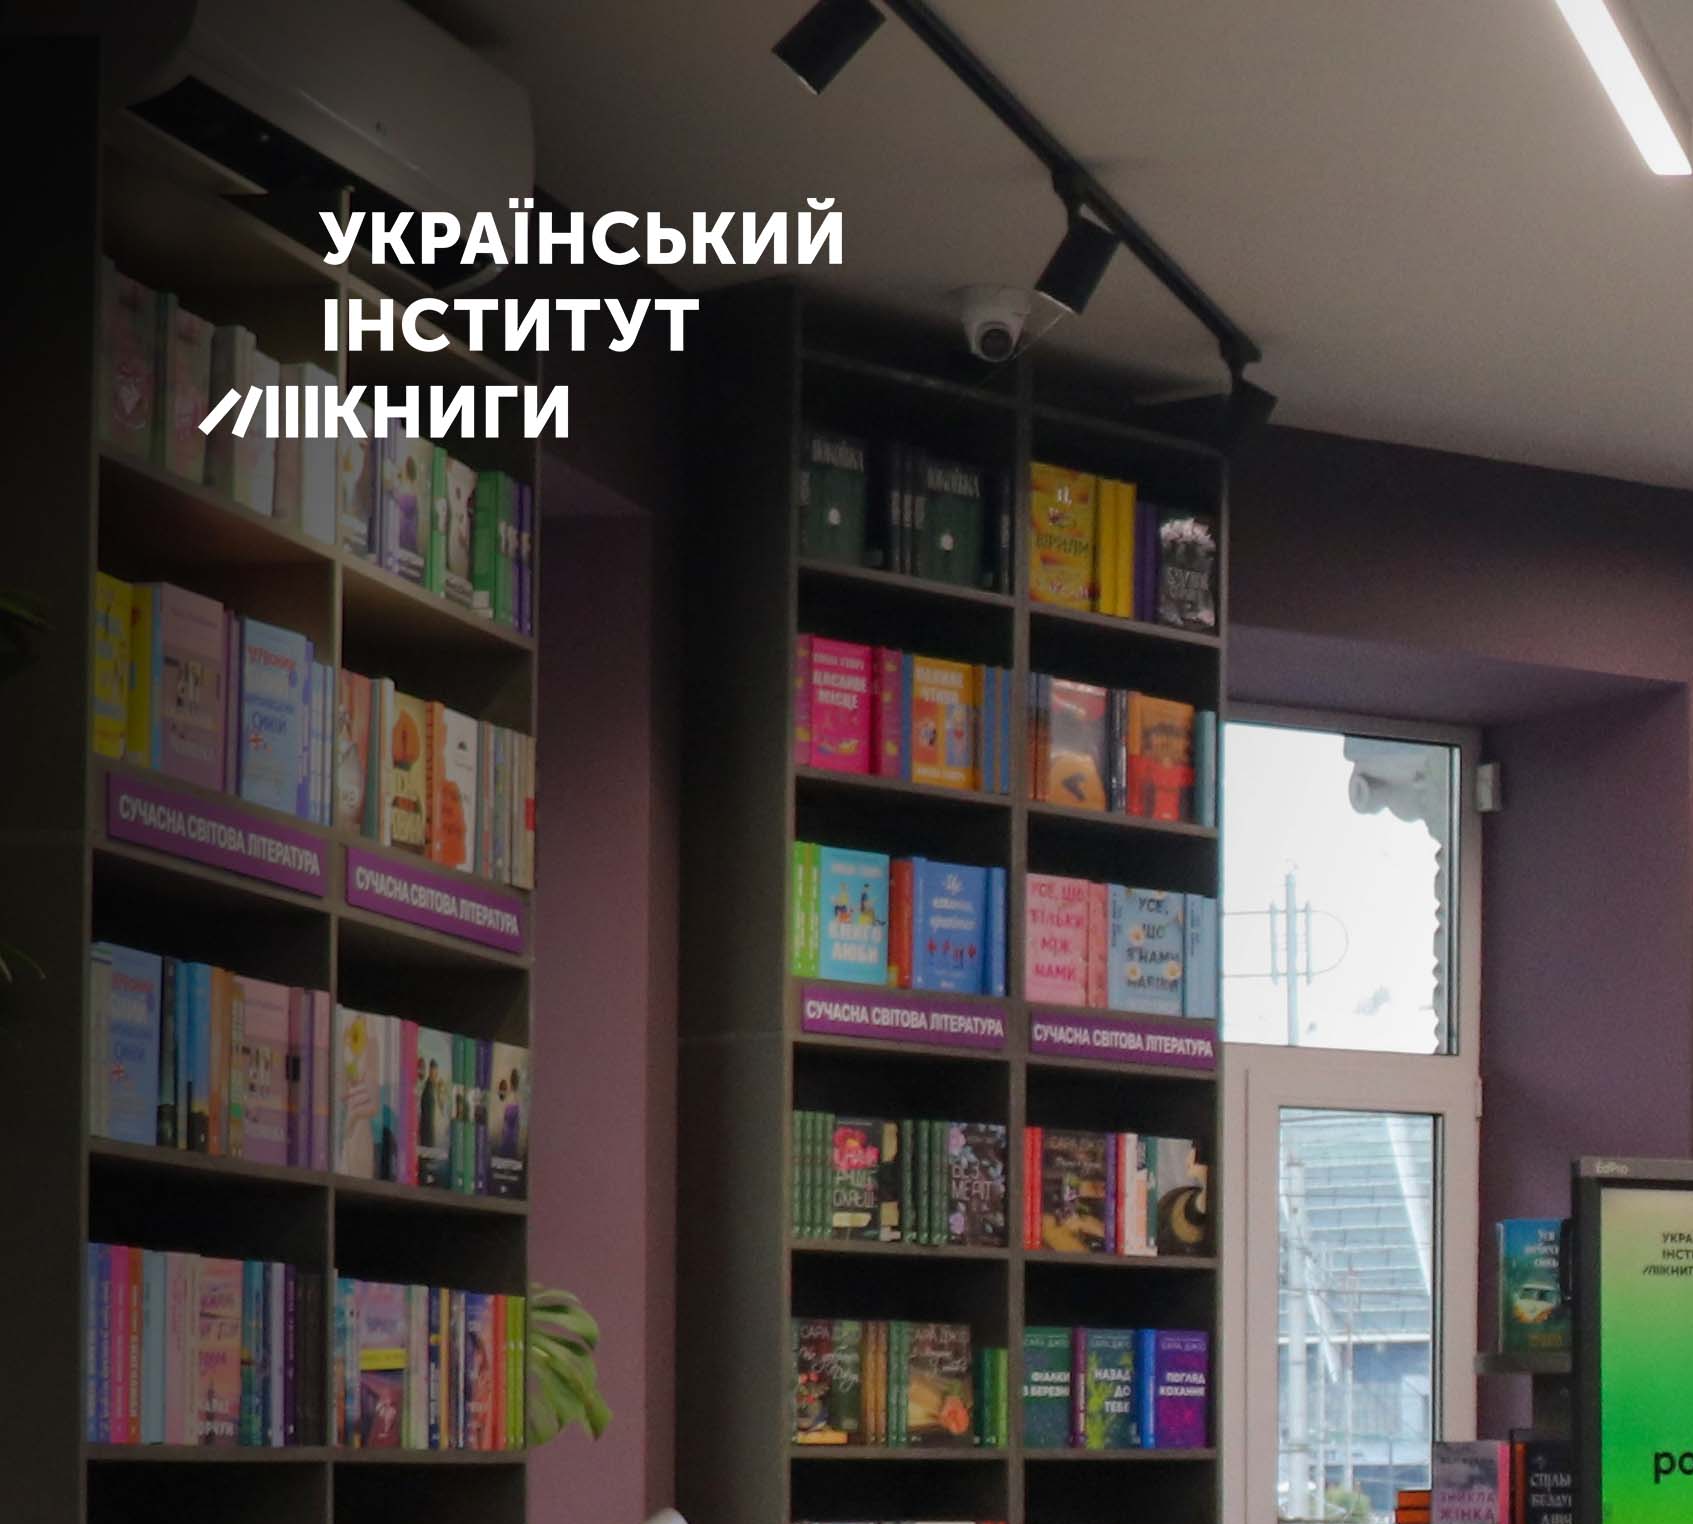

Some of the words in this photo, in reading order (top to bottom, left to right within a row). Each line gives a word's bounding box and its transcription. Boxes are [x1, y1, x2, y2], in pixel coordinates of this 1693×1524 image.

[119, 794, 186, 837] СУЧАСНА
[187, 815, 246, 855] СВІТОВА
[247, 833, 320, 877] ЛІТЕРАТУРА
[356, 865, 410, 905] СУЧАСНА
[410, 883, 458, 919] СВІТОВА
[460, 898, 519, 937] ЛІТЕРАТУРА
[806, 1000, 869, 1024] СУЧАСНА
[872, 1006, 928, 1030] СВІТОВА
[930, 1013, 1004, 1038] ЛІТЕРАТУРА
[1033, 1023, 1091, 1046] СУЧАСНА
[1093, 1029, 1144, 1050] СВІТОВА
[1145, 1034, 1214, 1058] ЛІТЕРАТУРА
[1440, 1508, 1494, 1521] ЖІНКА
